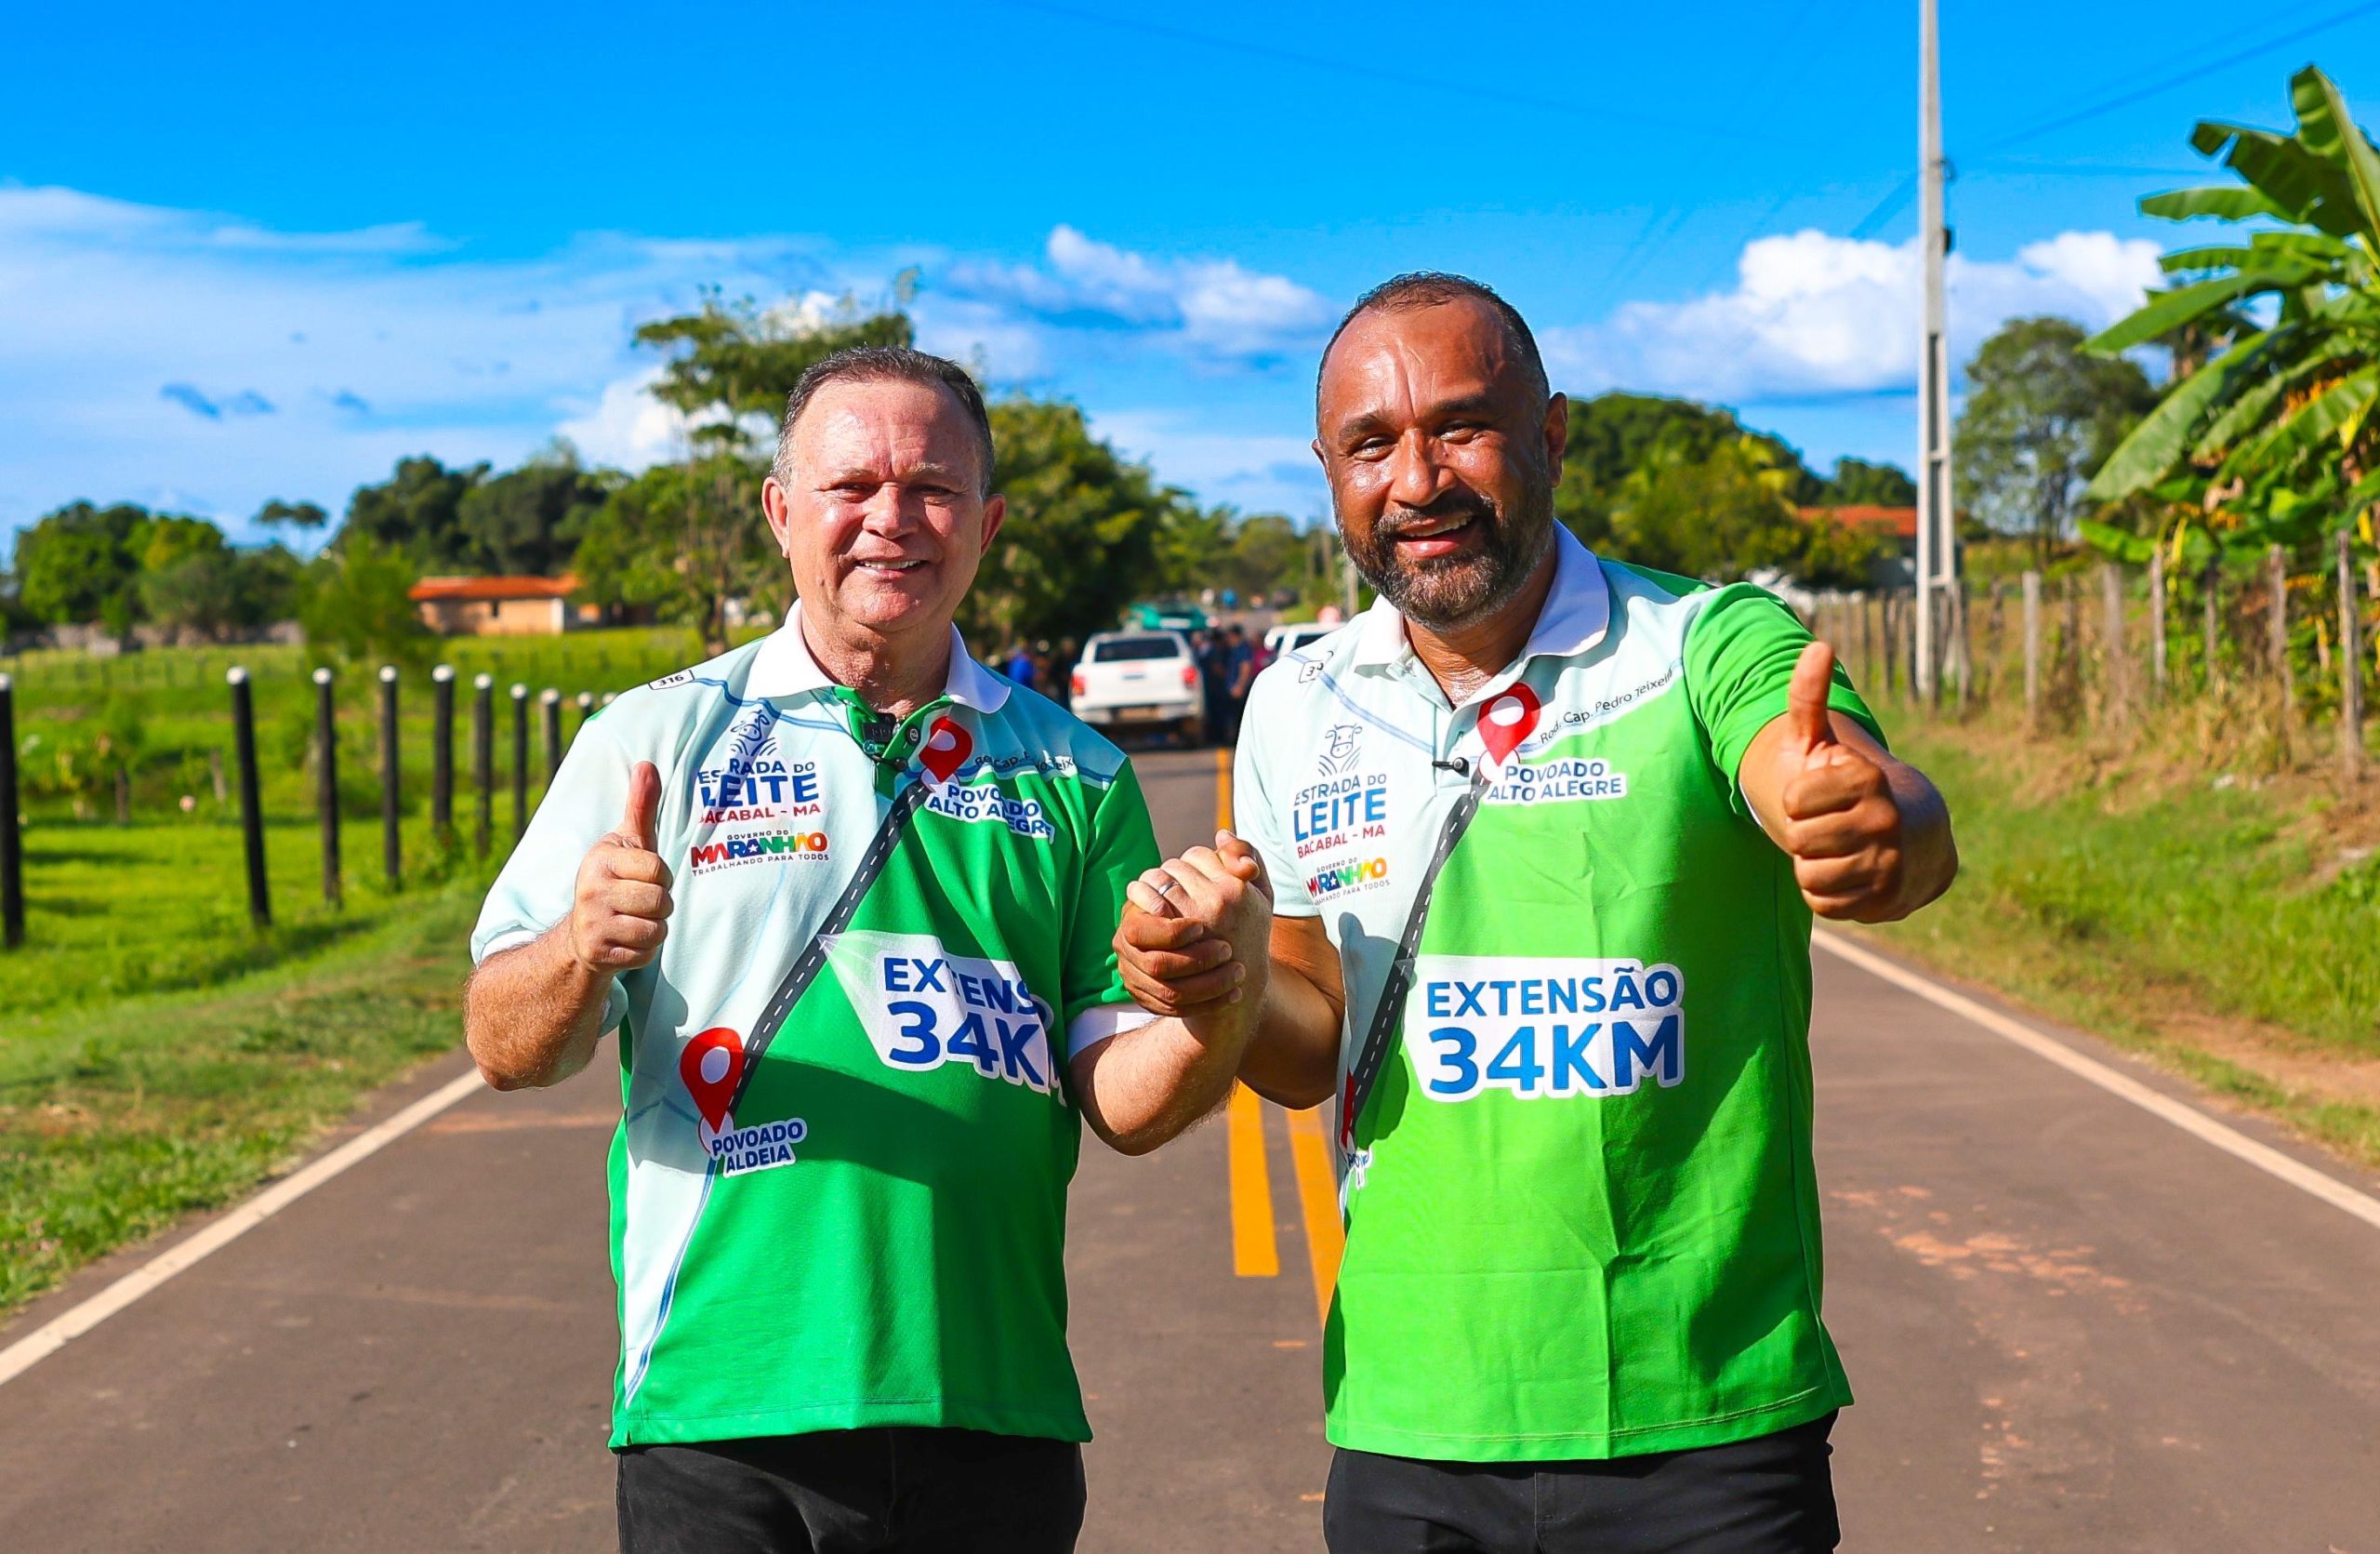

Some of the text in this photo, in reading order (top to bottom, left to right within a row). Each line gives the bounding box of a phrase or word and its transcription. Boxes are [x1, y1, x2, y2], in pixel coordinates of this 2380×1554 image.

[657, 674, 684, 686] 316
[1540, 720, 1562, 744] Rod.
[1563, 711, 1593, 723] Cap.
[1594, 693, 1632, 712] Pedro
[697, 757, 815, 784] ESRADA DO
[1505, 762, 1605, 783] POVOADO
[701, 773, 819, 807] LEITE
[1293, 774, 1387, 806] ESTRADA DO
[1488, 777, 1621, 802] ALTO ALEGRE
[700, 807, 774, 824] ACABAL
[793, 803, 821, 817] MA
[929, 796, 979, 818] ALTO
[1293, 788, 1386, 843] LEITE
[727, 830, 772, 841] GOVERNO
[1297, 832, 1348, 858] BACABAL
[1363, 824, 1385, 839] MA
[693, 853, 829, 877] TRABALHANDO PARA TODOS
[1316, 857, 1358, 873] GOVERNO DO
[1342, 887, 1361, 896] PARA
[1365, 880, 1390, 890] TODOS
[1426, 966, 1678, 1017] EXTENSÃO
[887, 1001, 1059, 1086] 34K
[1429, 1014, 1678, 1095] 34KM
[711, 1122, 803, 1156] POVOADO
[726, 1144, 790, 1173] ALDEIA
